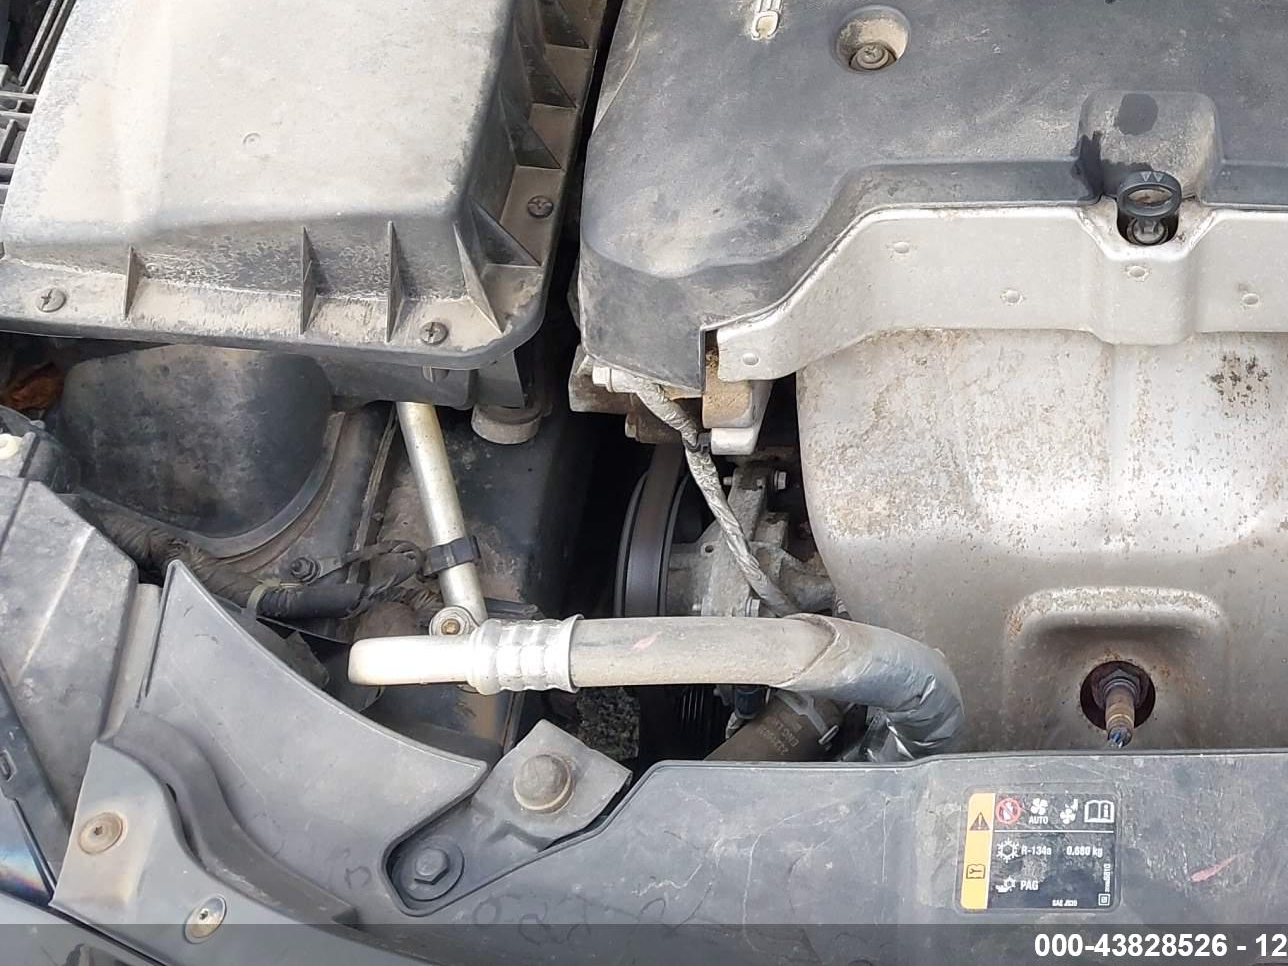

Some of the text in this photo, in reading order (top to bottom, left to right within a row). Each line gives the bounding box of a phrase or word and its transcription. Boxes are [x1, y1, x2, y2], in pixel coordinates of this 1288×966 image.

[1028, 816, 1049, 825] AUTO
[1021, 845, 1052, 856] R-134a
[1092, 845, 1103, 858] kg
[1020, 881, 1039, 891] PAG
